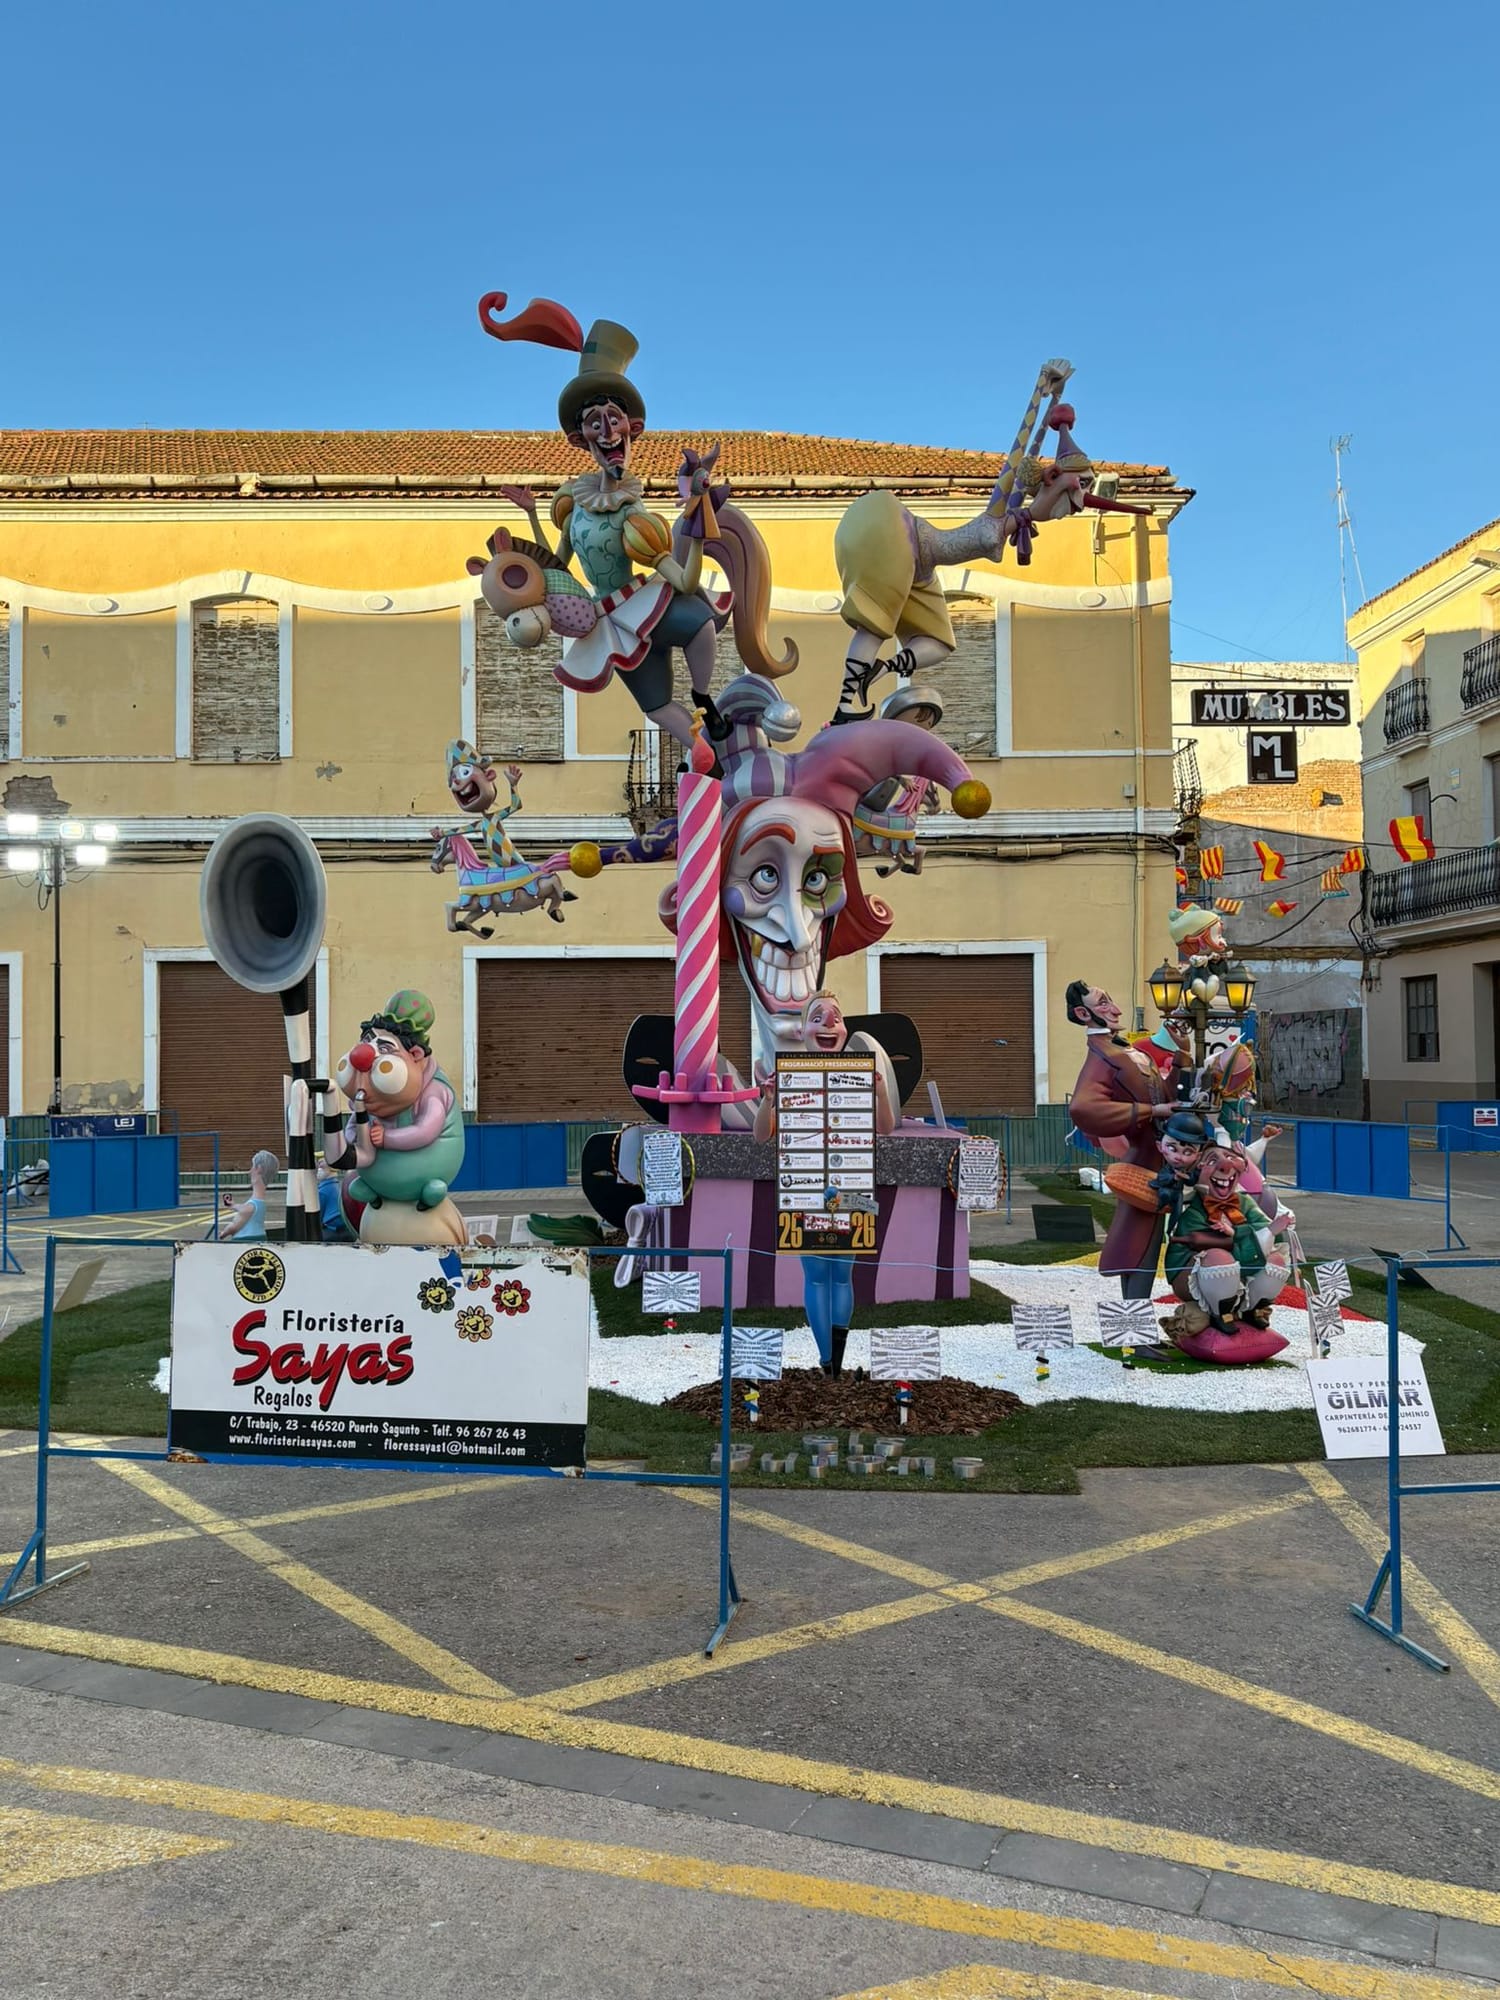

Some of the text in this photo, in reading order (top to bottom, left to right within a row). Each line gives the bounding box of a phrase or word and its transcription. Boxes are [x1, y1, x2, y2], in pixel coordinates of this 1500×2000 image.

[1200, 693, 1346, 721] MUBLES
[779, 1212, 803, 1248] 25
[851, 1212, 875, 1248] 26
[283, 1309, 404, 1334] Floristería
[231, 1309, 414, 1412] Sayas
[253, 1386, 313, 1412] Regalos
[229, 1416, 244, 1429] C/
[246, 1416, 282, 1433] Trabajo,
[285, 1419, 299, 1431] 23
[310, 1420, 345, 1432] 46520
[348, 1420, 380, 1434] Puerto
[381, 1422, 421, 1438] Sagunto
[432, 1424, 453, 1437] Telf.
[456, 1425, 470, 1437] 96
[473, 1426, 493, 1438] 267
[495, 1427, 510, 1439] 26
[512, 1428, 527, 1440] 43
[229, 1433, 357, 1451] www.floristeriasayas.com
